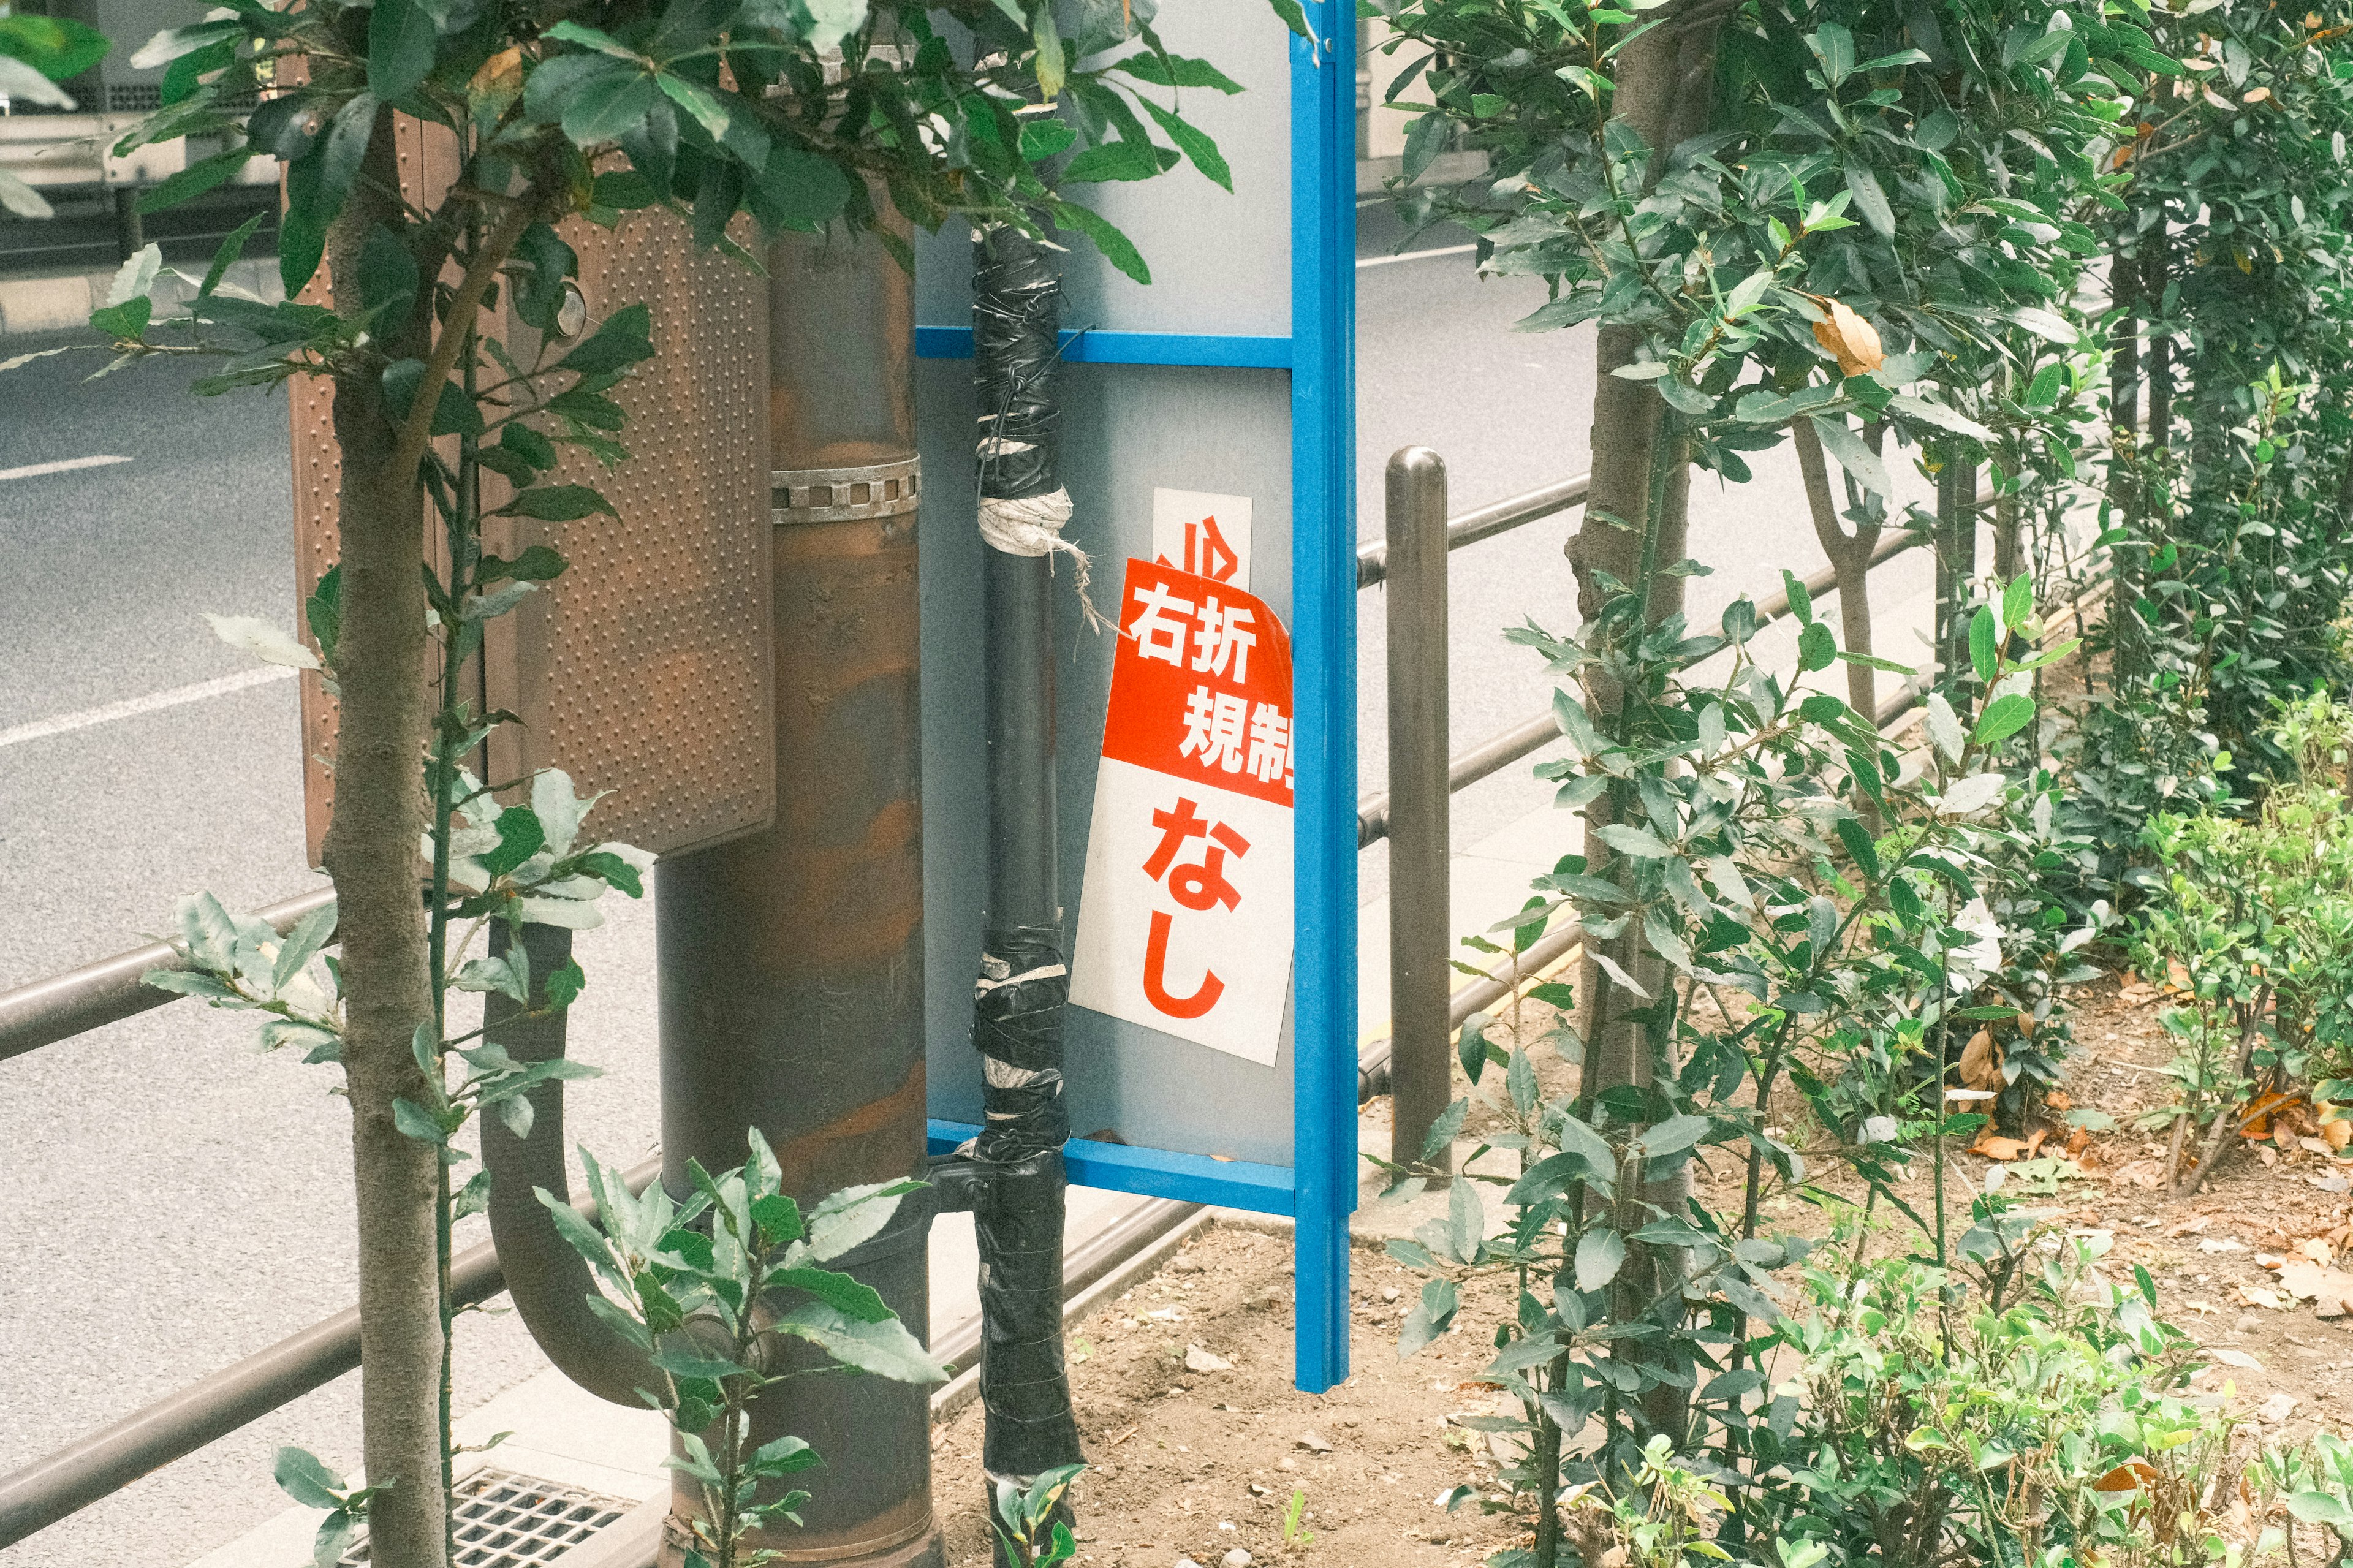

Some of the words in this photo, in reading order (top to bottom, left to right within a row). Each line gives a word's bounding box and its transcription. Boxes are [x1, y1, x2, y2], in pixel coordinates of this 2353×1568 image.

[1129, 581, 1256, 684] 右折
[1179, 684, 1294, 789] 規制
[1142, 797, 1251, 1018] なし
